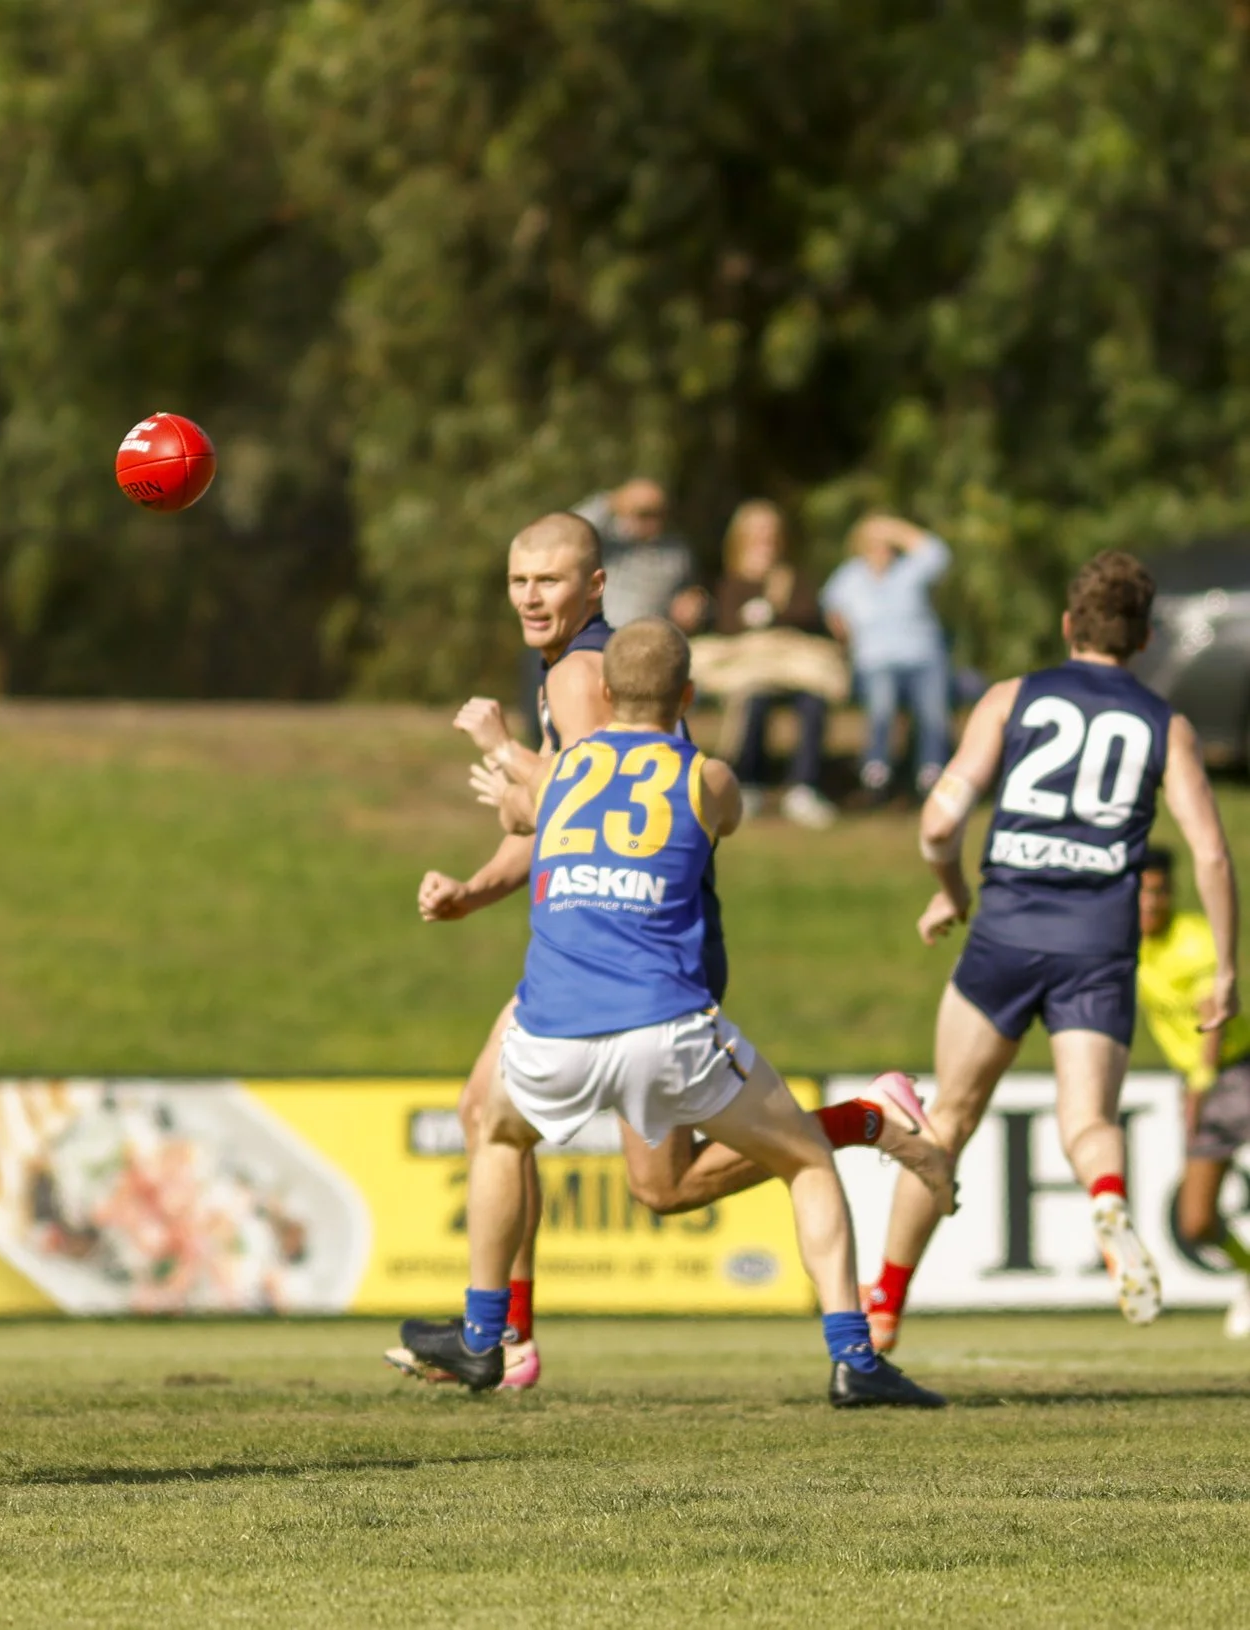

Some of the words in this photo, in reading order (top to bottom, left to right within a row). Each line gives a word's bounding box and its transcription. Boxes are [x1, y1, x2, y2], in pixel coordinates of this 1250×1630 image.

[538, 741, 682, 861] 23
[1001, 696, 1152, 828] 20
[547, 864, 667, 905] ASKIN
